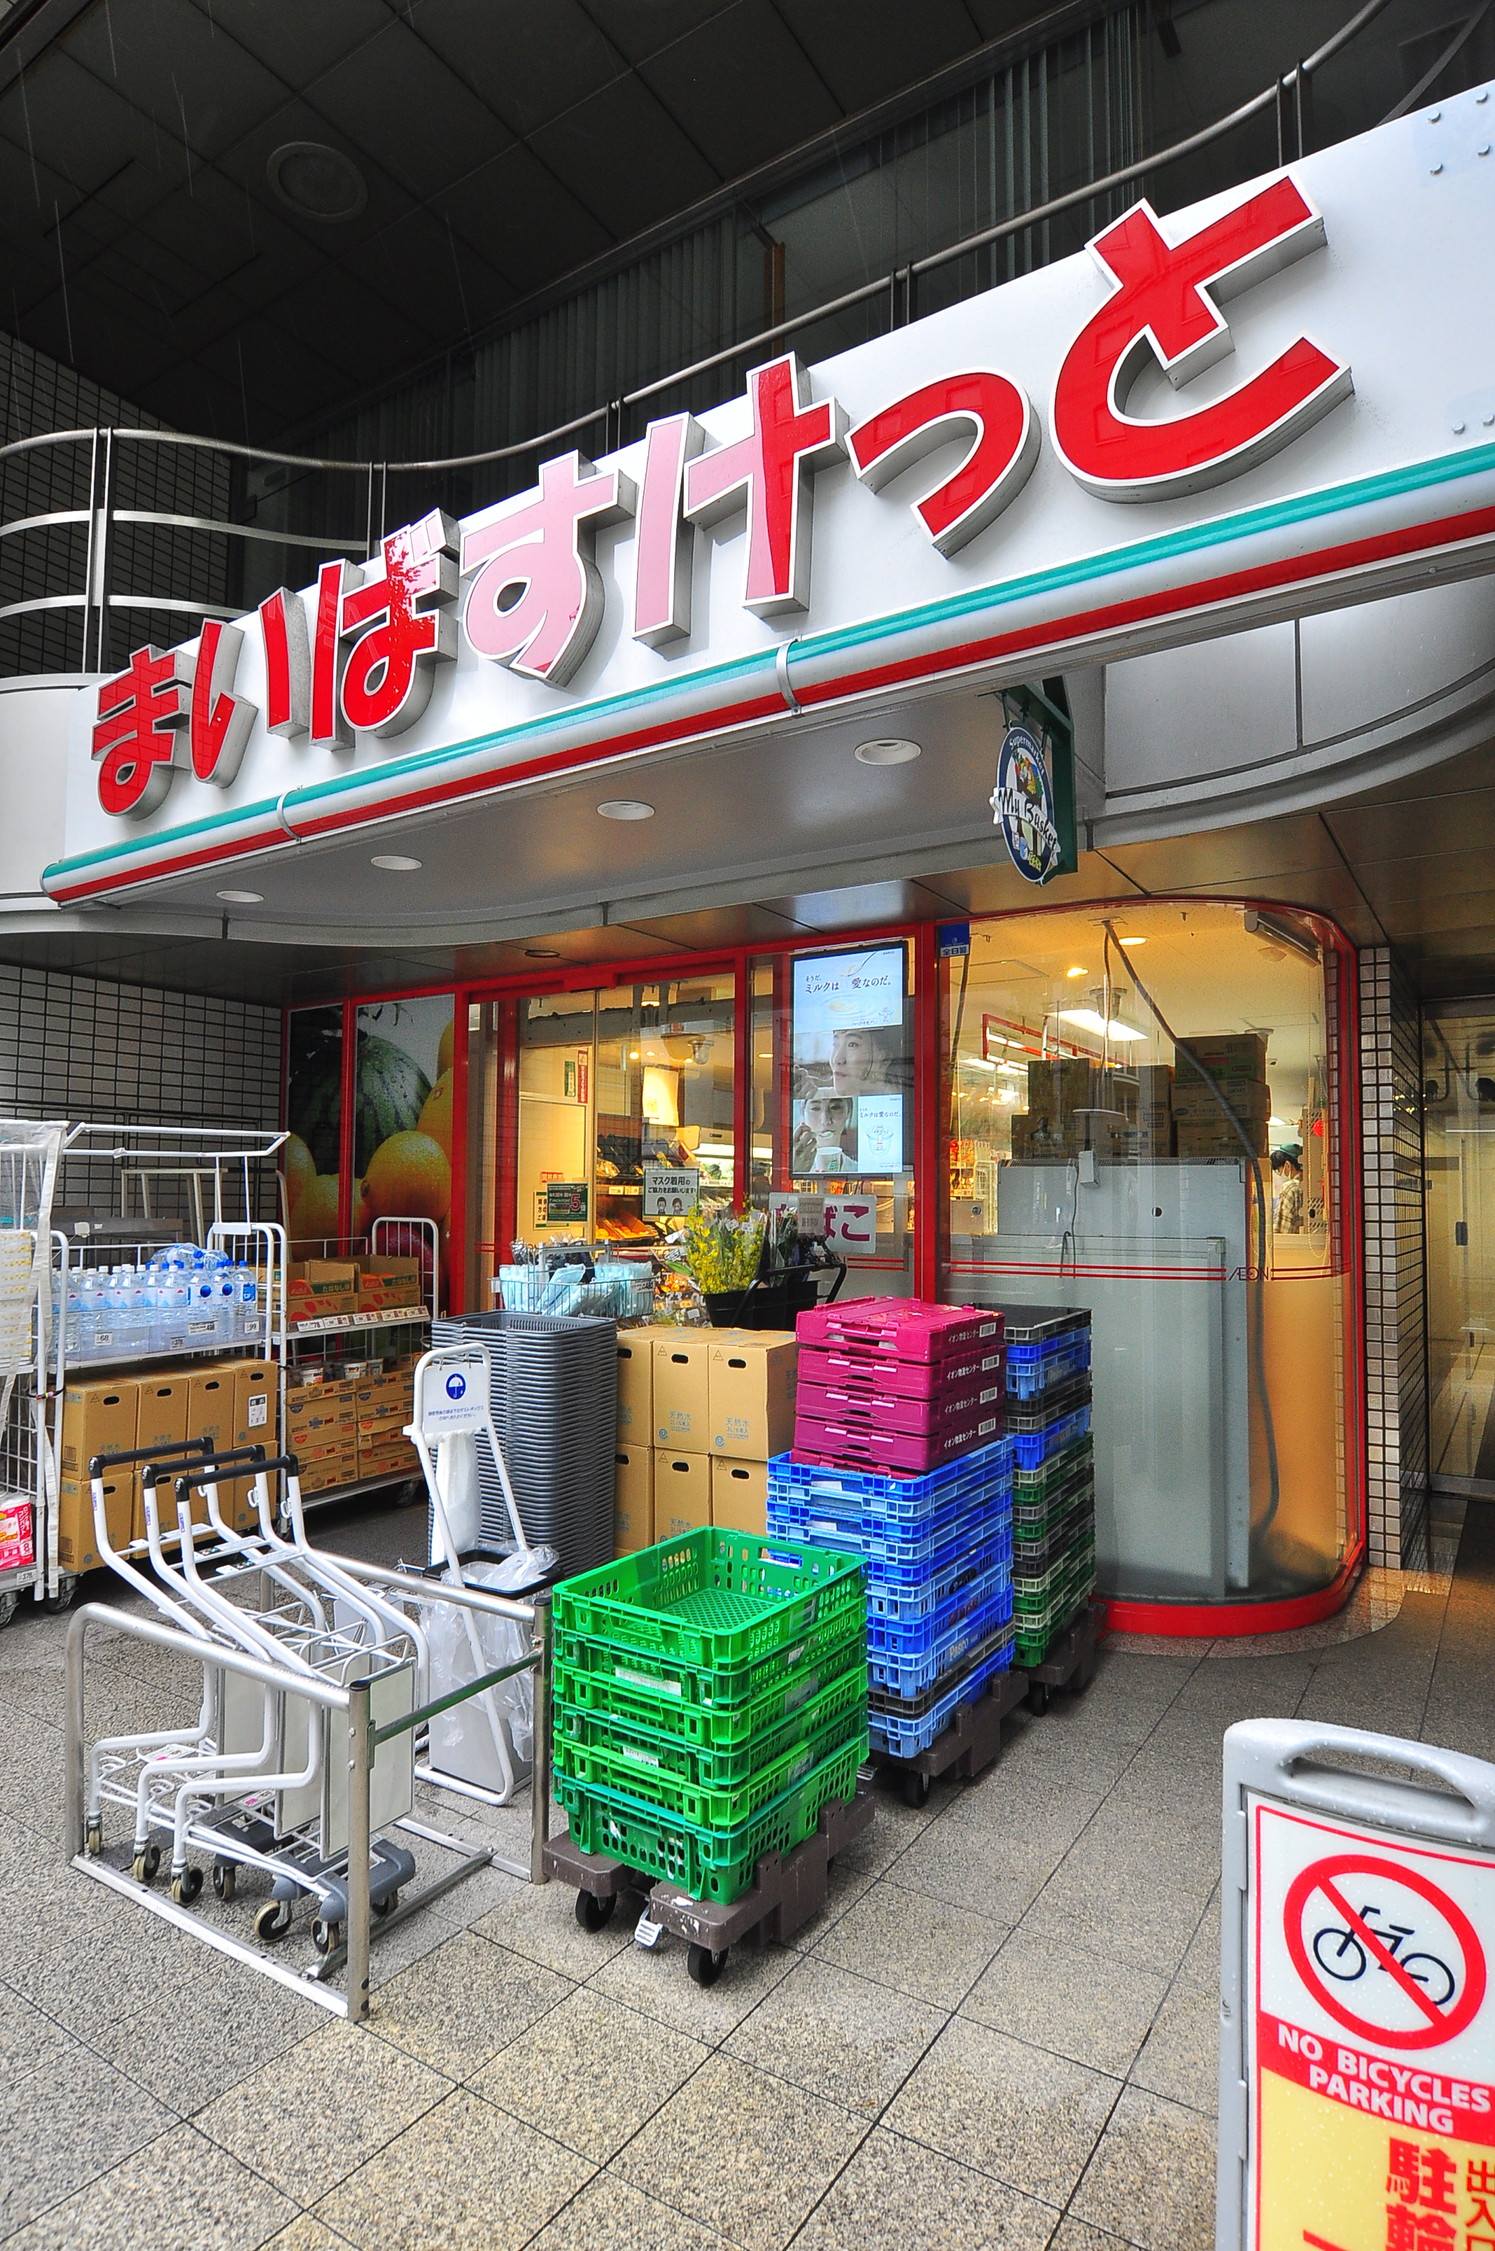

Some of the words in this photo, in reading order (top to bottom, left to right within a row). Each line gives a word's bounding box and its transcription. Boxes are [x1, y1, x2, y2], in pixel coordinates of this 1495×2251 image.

[92, 168, 1352, 818] まいばすけっと
[1009, 735, 1044, 776] Supermarket
[999, 787, 1021, 817] My
[1024, 803, 1057, 851] Basket
[805, 981, 840, 994] ミルクは
[652, 1176, 691, 1186] マスク着用の
[1278, 2023, 1323, 2061] NO
[1337, 2048, 1491, 2113] BICYCLES
[1309, 2064, 1454, 2134] PARKING
